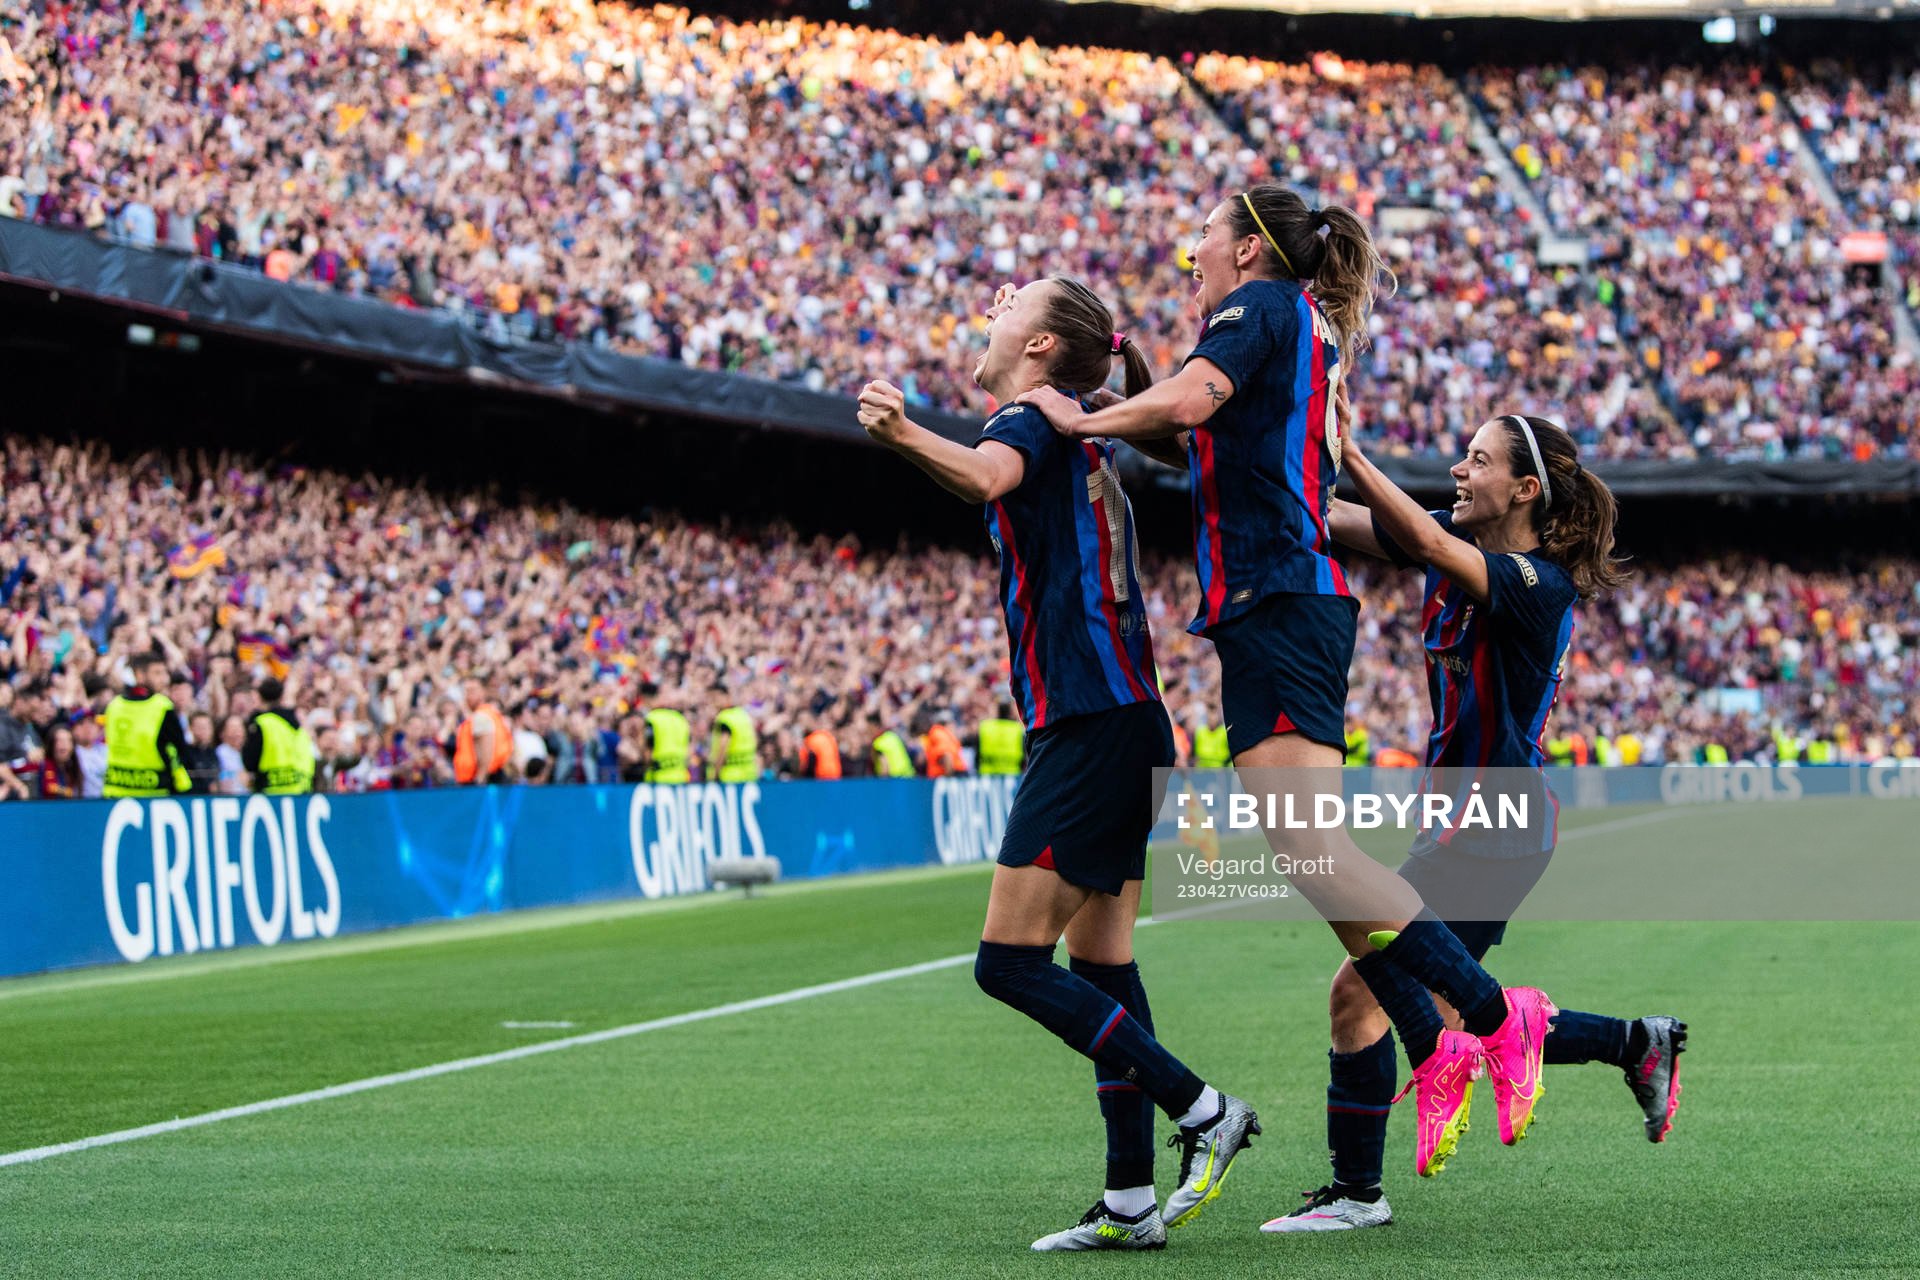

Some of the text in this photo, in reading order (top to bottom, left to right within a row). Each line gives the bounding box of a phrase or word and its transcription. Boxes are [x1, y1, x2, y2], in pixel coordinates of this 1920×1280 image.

[629, 782, 767, 898] GRIFOLS
[1660, 760, 1804, 804] GRIFOLS
[102, 795, 341, 962] GRIFOLS
